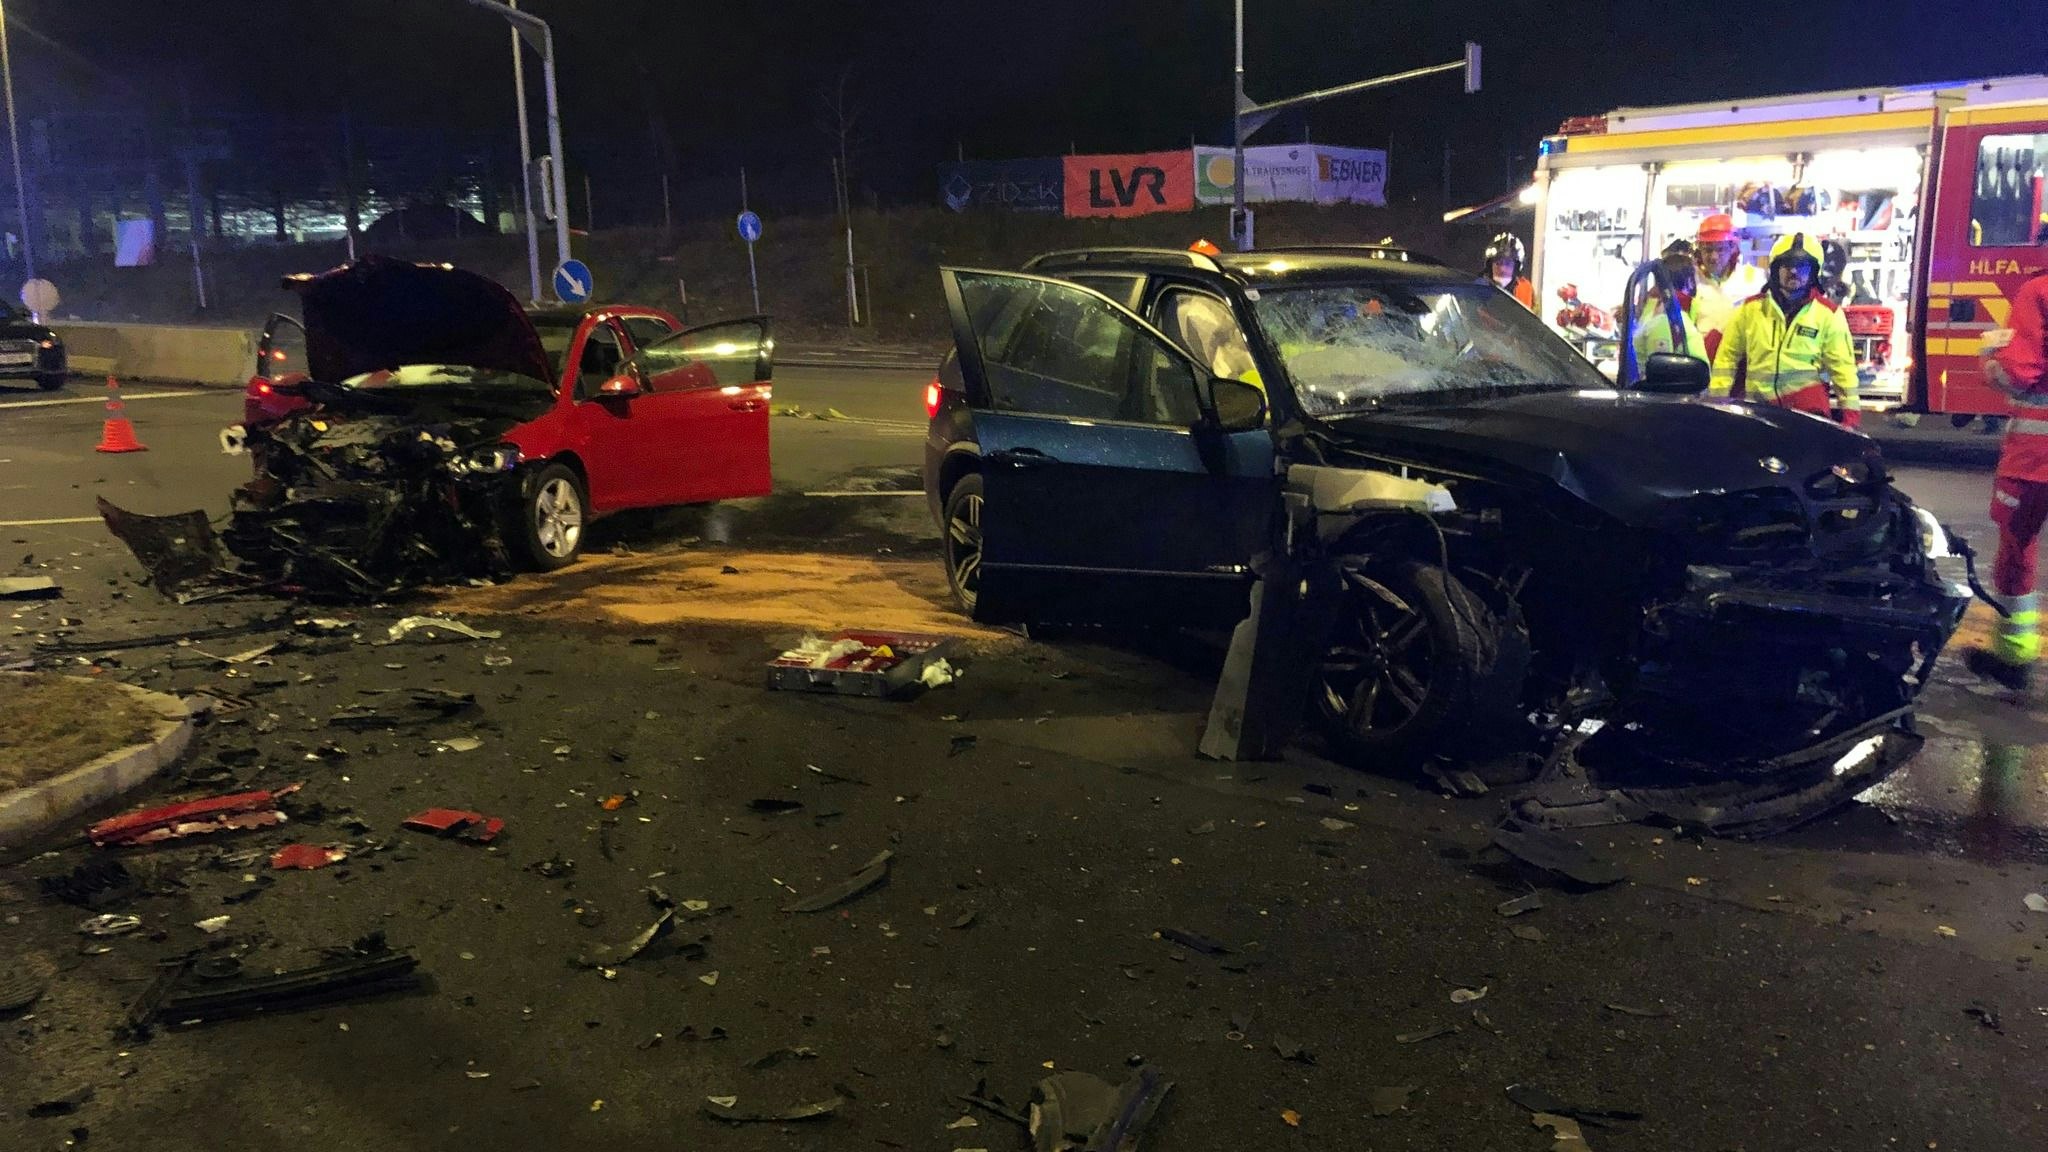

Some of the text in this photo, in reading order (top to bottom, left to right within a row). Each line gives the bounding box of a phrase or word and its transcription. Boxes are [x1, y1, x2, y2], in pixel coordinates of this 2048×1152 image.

[1331, 158, 1383, 183] EBNER
[1090, 167, 1166, 208] LVR
[1969, 259, 2021, 275] HLFA
